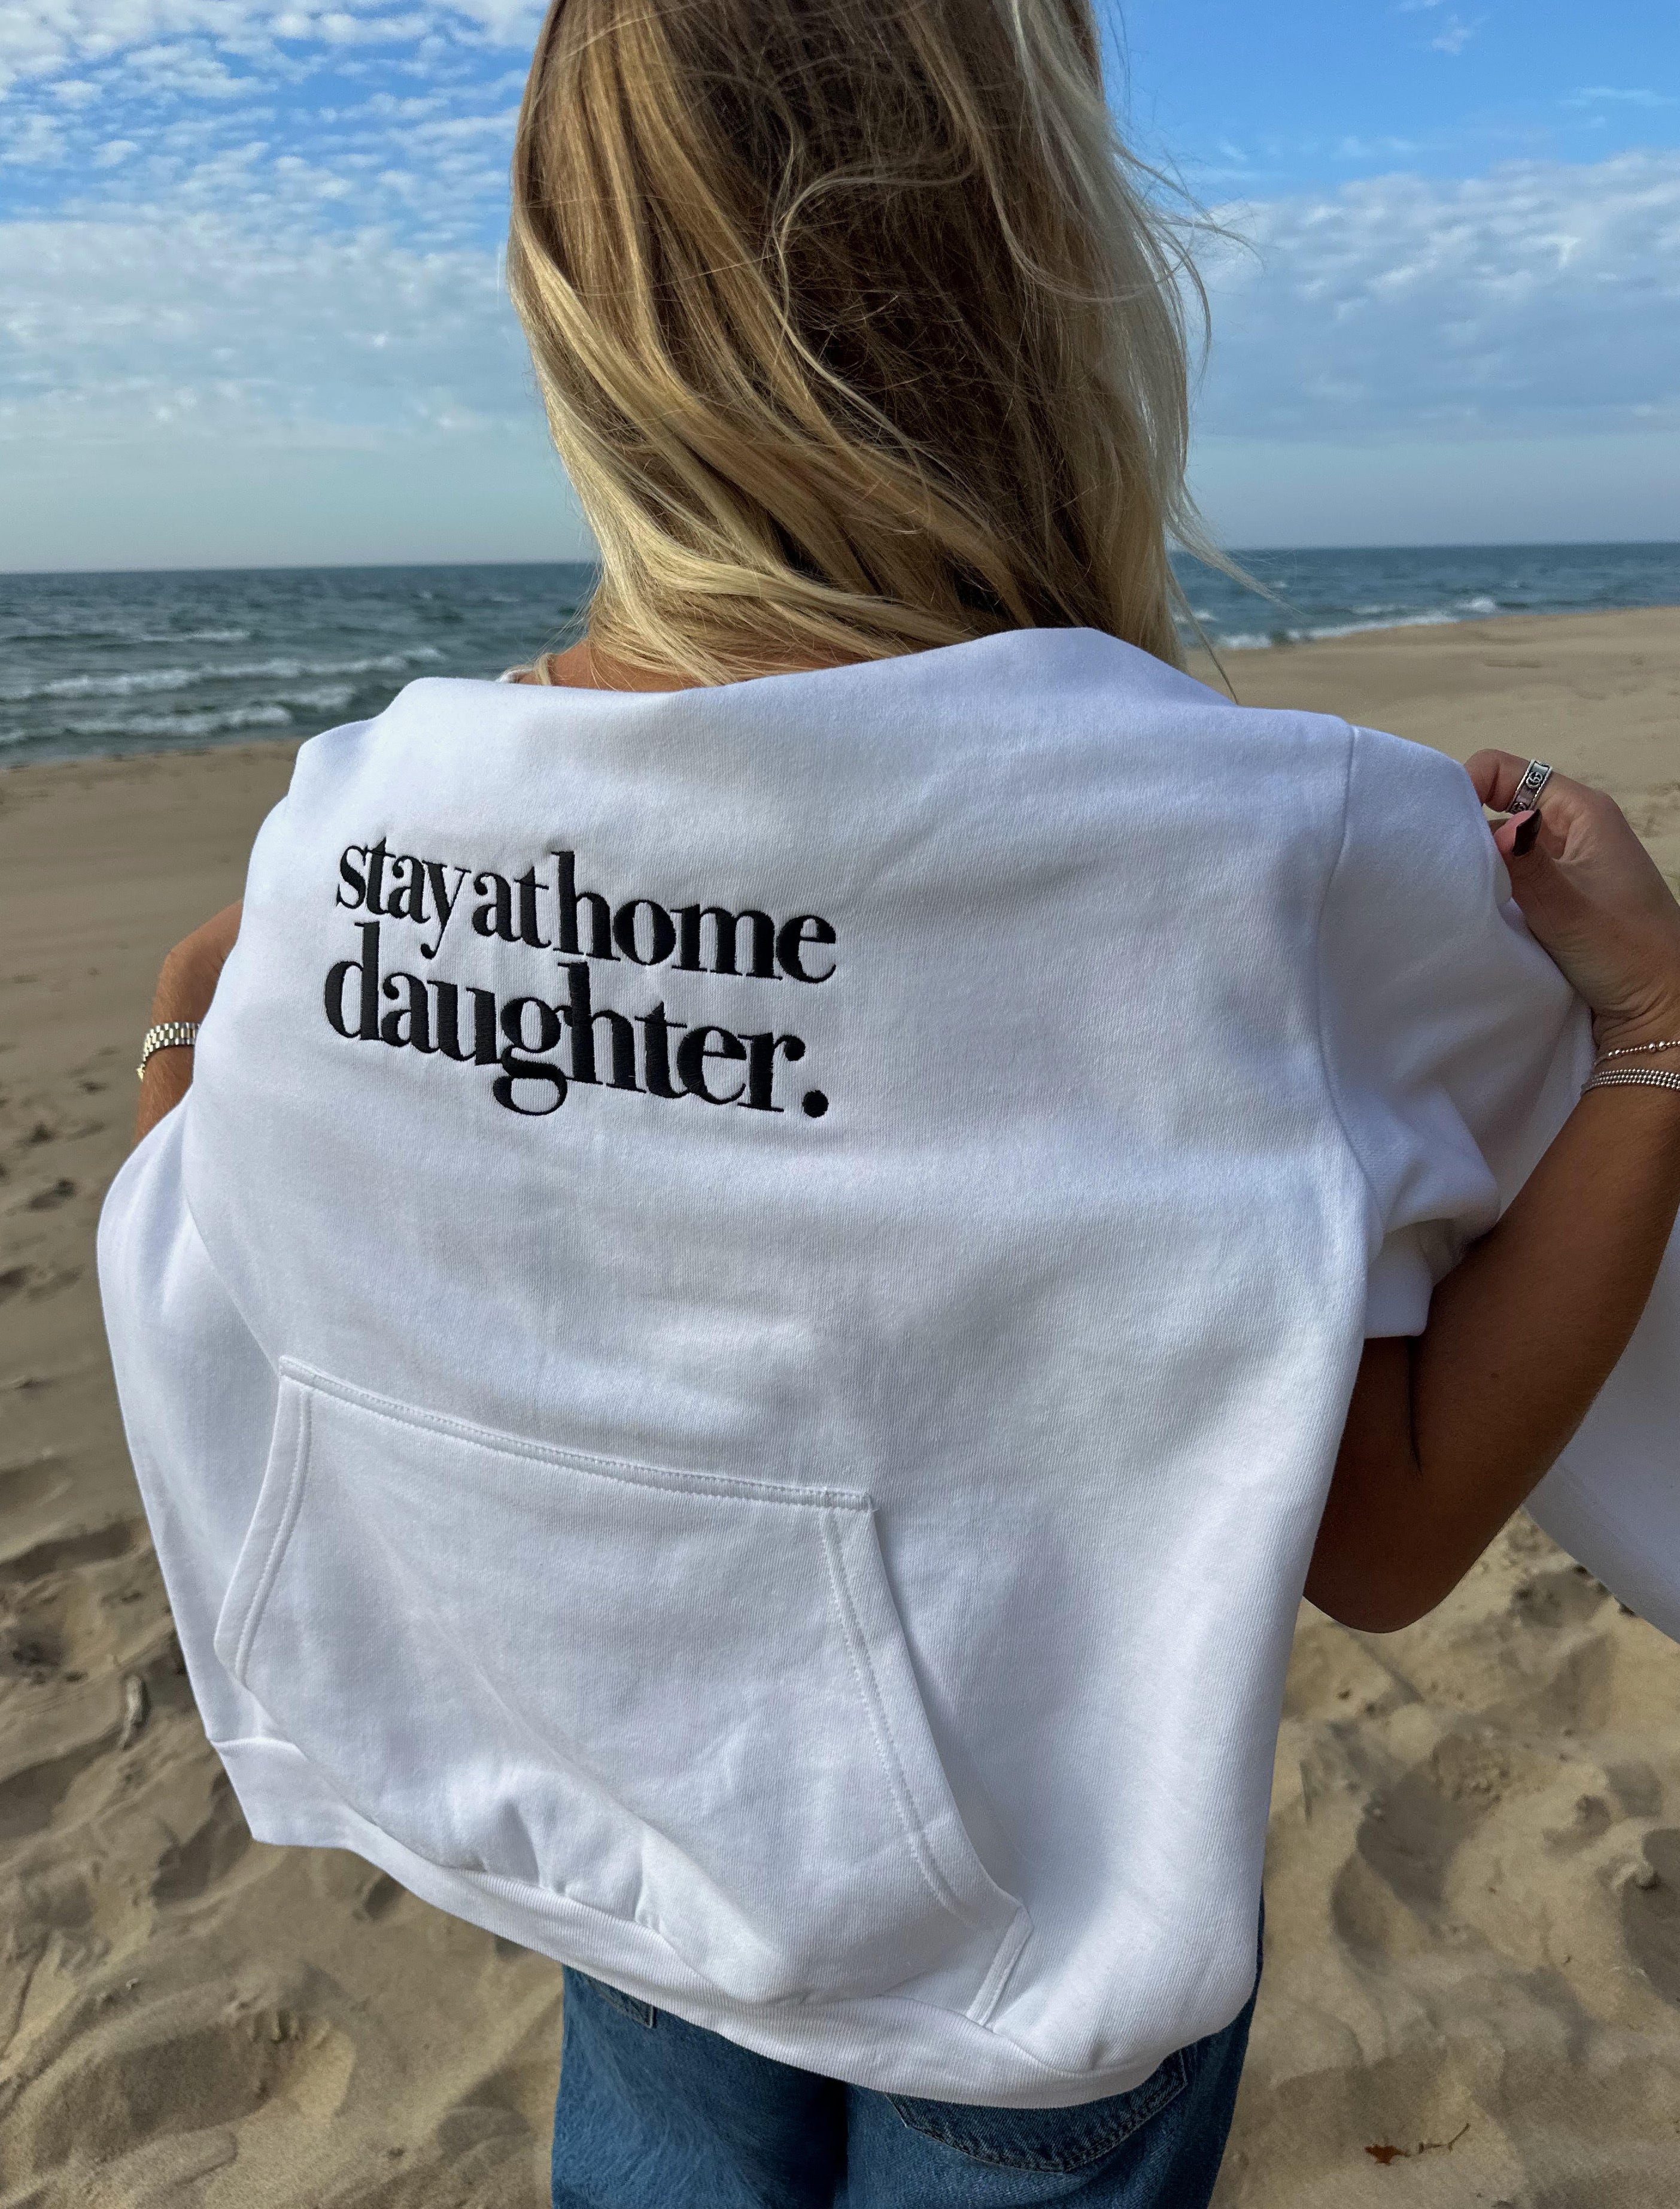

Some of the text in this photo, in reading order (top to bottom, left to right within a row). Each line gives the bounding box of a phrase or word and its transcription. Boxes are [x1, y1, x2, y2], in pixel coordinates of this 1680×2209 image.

[336, 837, 836, 984] stay at home
[324, 921, 829, 1118] daughter.
